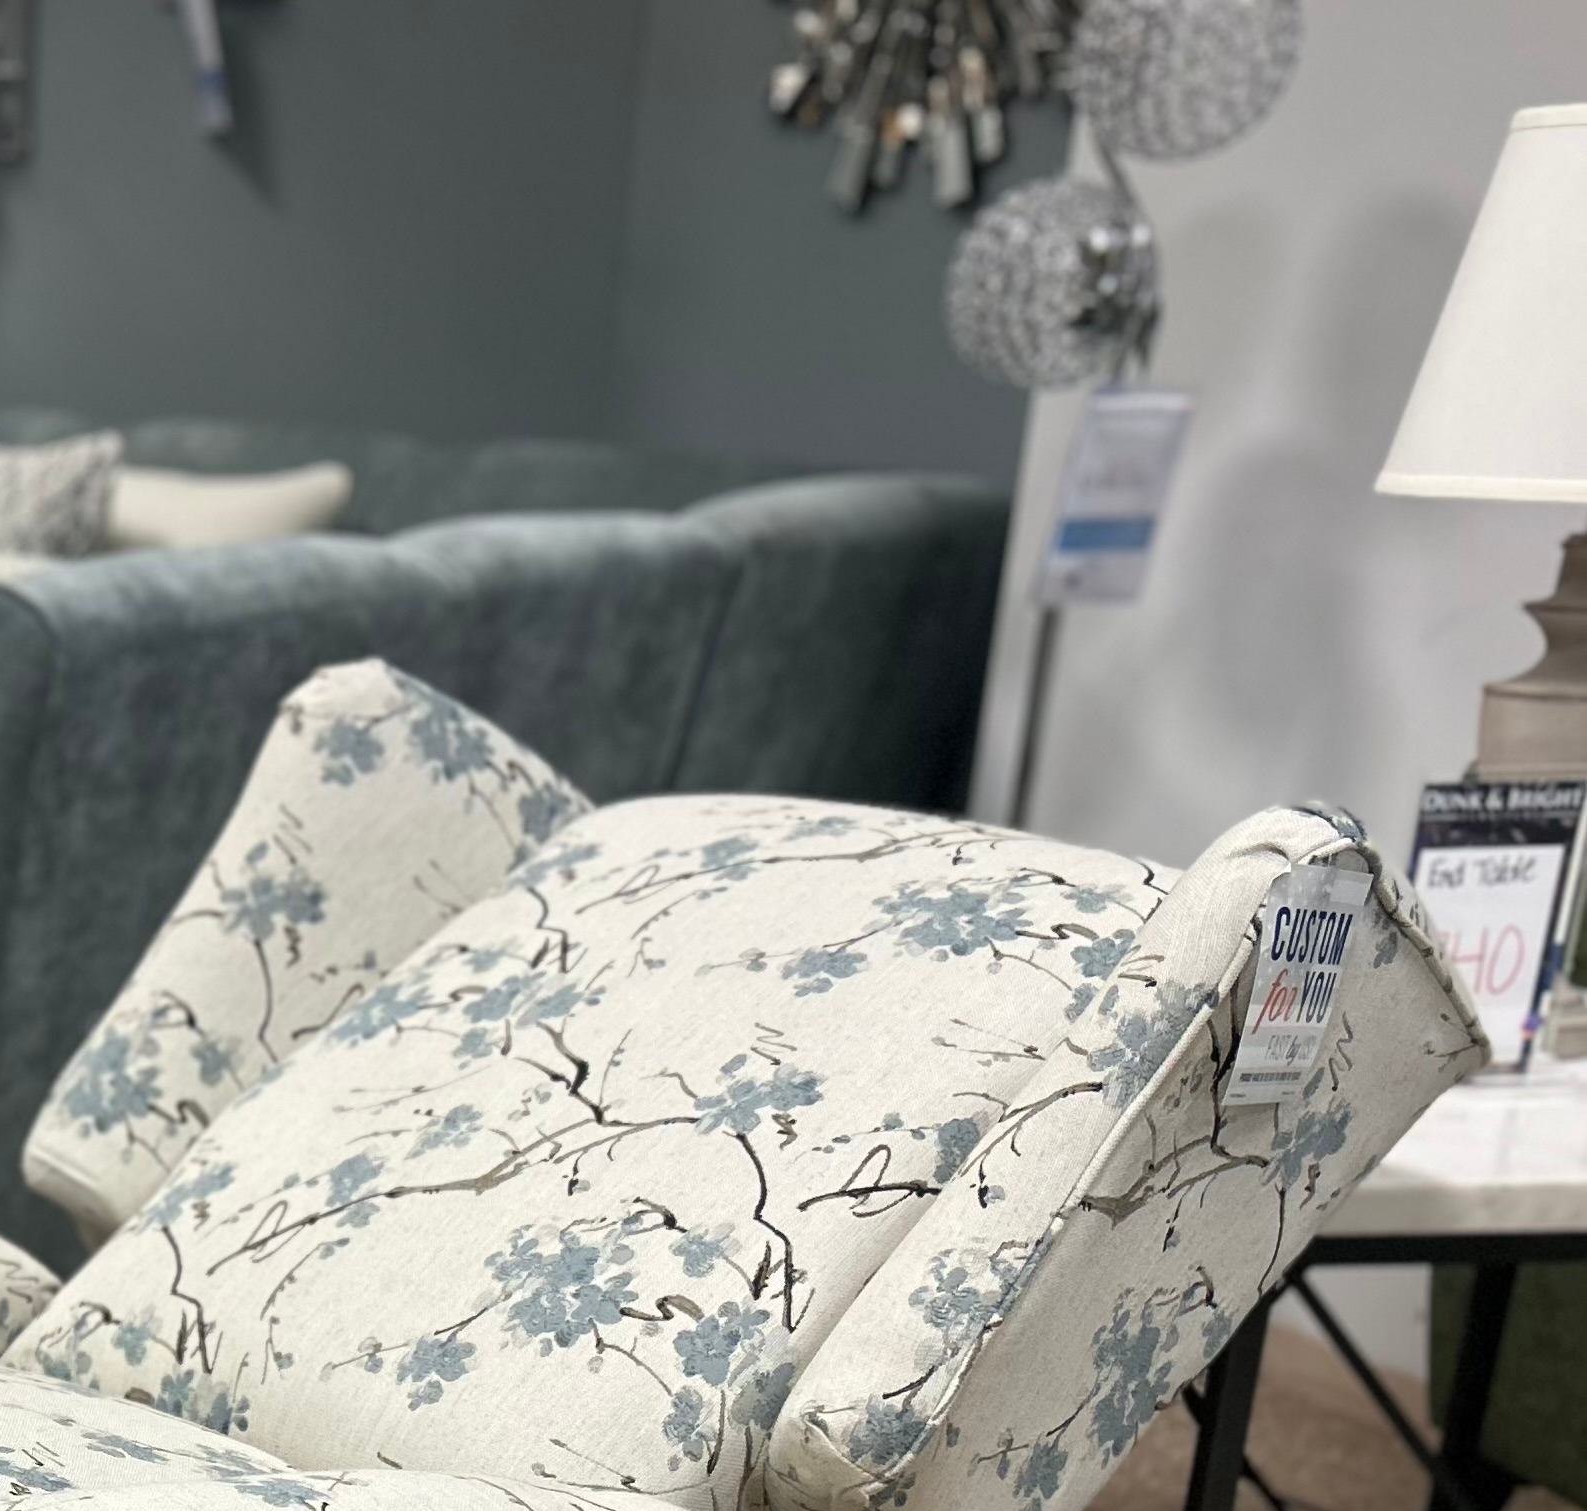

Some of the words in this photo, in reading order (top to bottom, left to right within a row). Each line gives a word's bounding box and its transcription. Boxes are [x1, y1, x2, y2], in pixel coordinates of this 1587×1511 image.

[1423, 789, 1483, 812] DUNK
[1486, 788, 1503, 811] &
[1508, 786, 1582, 811] BRIGHT
[1428, 856, 1465, 889] End
[1473, 854, 1536, 887] Table
[1270, 906, 1353, 966] CUSTOM
[1251, 968, 1297, 1034] for
[1296, 971, 1338, 1024] YOU
